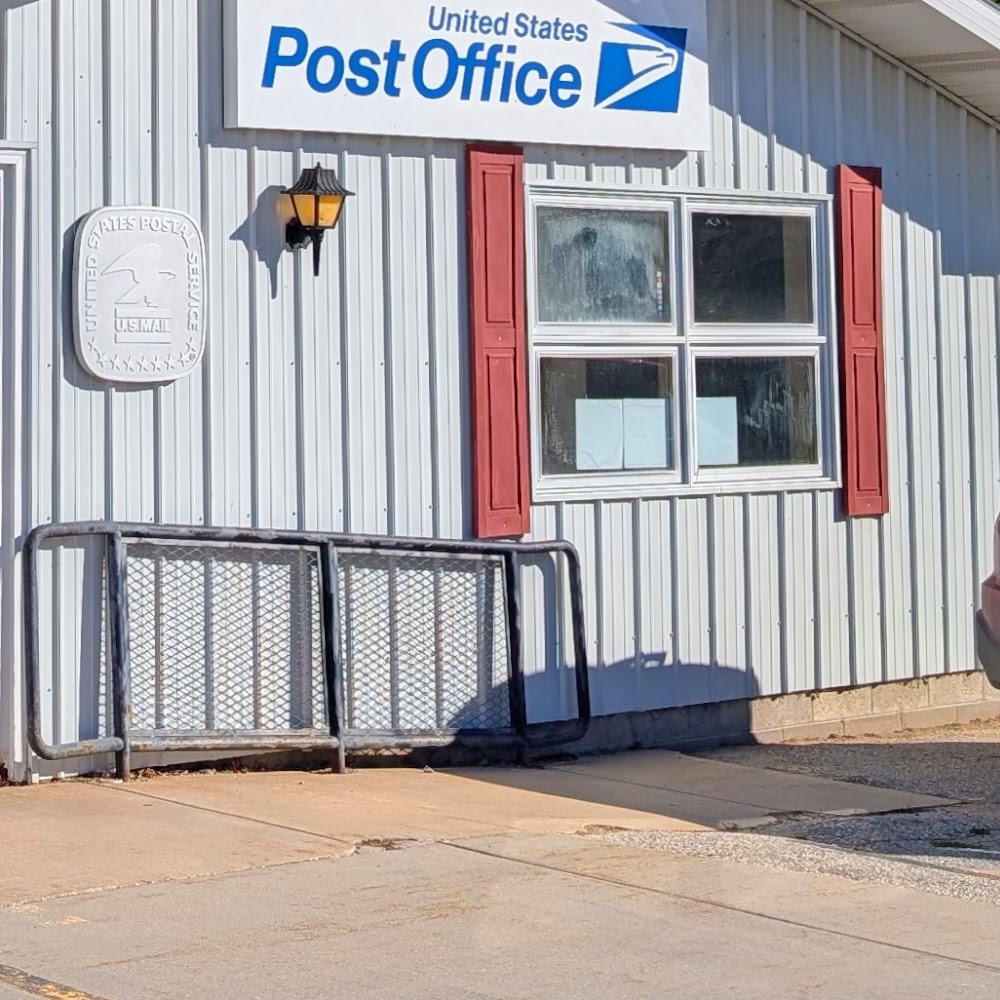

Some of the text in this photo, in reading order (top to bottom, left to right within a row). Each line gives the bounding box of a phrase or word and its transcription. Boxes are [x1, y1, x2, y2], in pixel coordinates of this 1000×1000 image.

[428, 5, 588, 42] United States
[261, 25, 582, 109] Post Office
[85, 216, 199, 332] UNITED STATES POSTAL SERVICE
